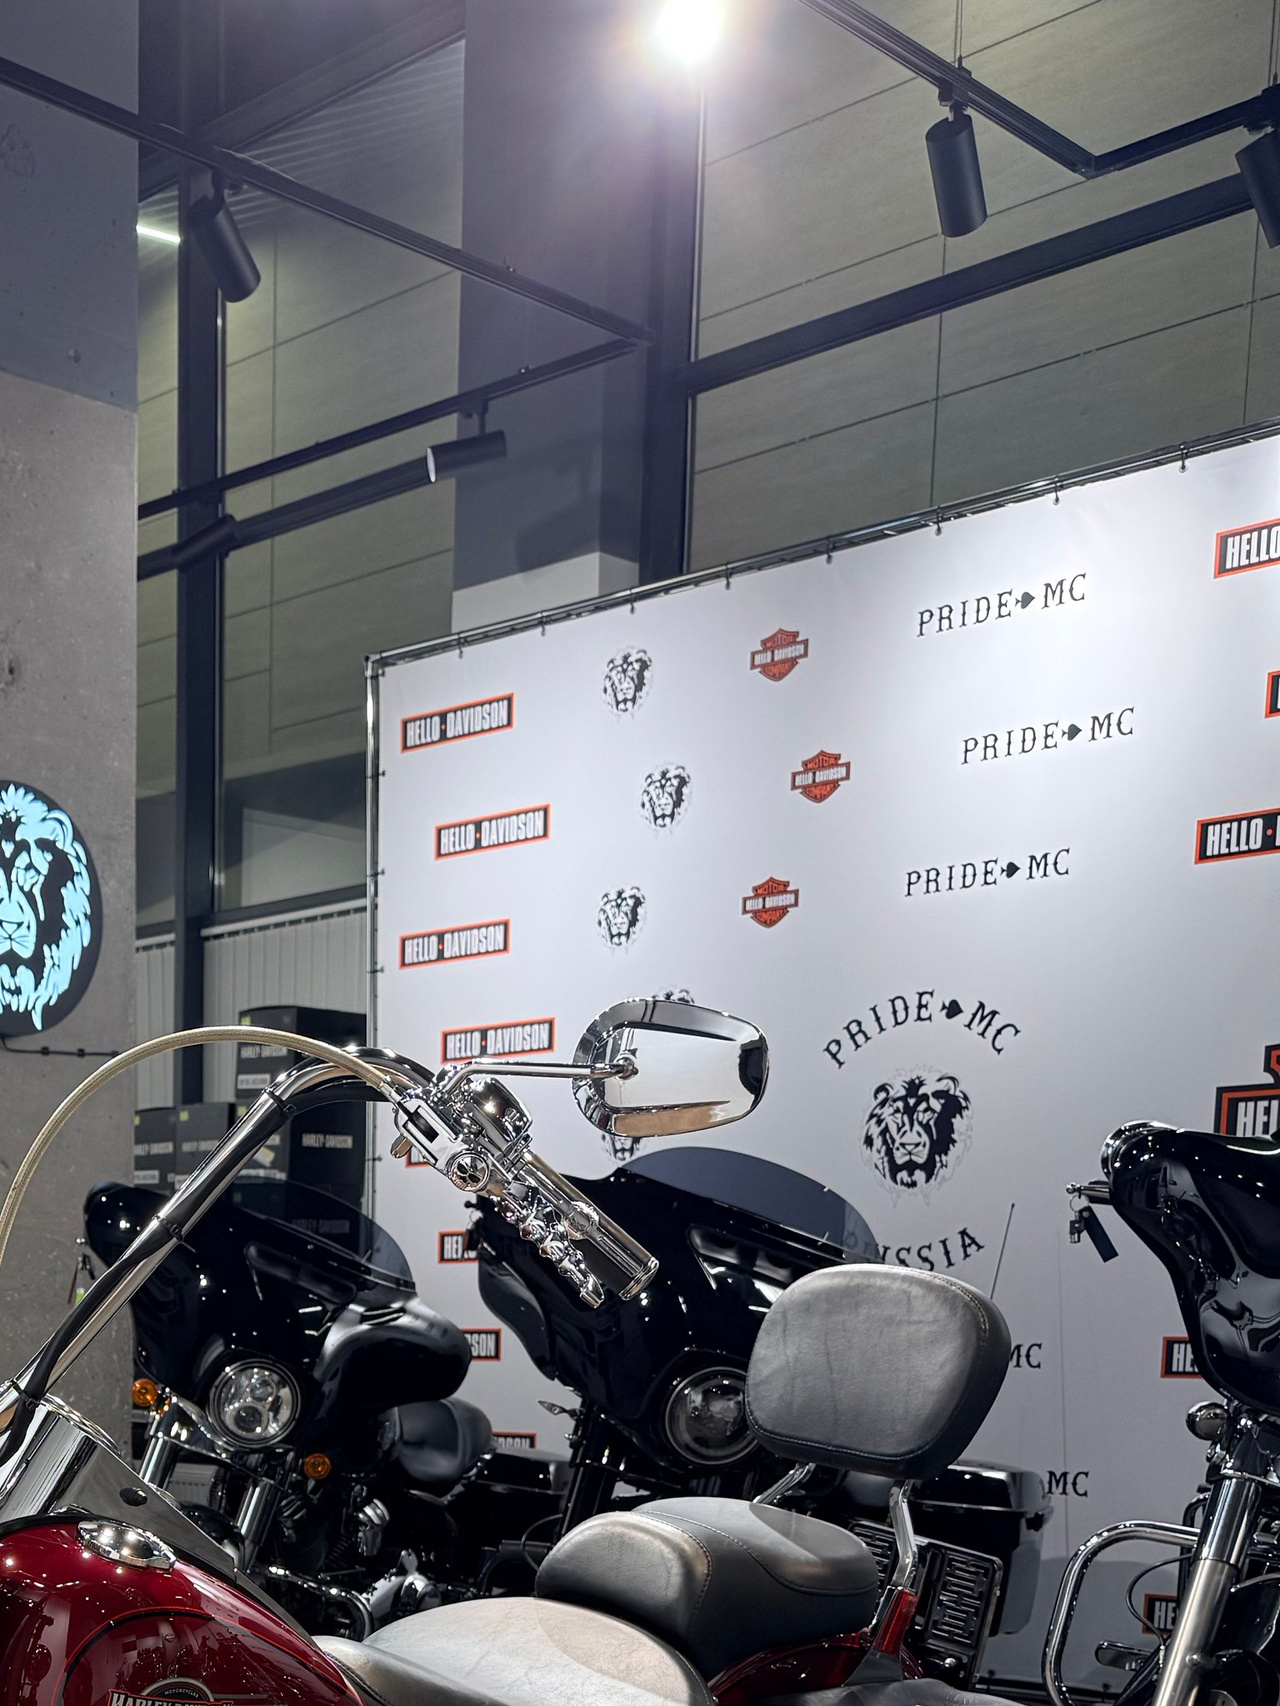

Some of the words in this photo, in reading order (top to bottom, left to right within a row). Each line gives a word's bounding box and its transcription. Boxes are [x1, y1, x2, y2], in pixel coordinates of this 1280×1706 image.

[1225, 525, 1280, 570] HELLO
[916, 588, 1013, 638] PRIDE
[1041, 572, 1087, 610] MC
[406, 715, 441, 748] HELLO
[446, 699, 509, 739] DAVIDSON
[961, 719, 1059, 765] PRIDE
[1088, 706, 1135, 742] MC
[440, 823, 476, 855] HELLO
[480, 809, 545, 848] DAVIDSON
[1206, 817, 1263, 857] HELLO
[904, 857, 999, 897] PRIDE
[1025, 847, 1070, 880] MC
[404, 935, 438, 965] HELLO
[443, 923, 506, 959] DAVIDSON
[446, 1030, 481, 1060] HELLO
[486, 1022, 550, 1055] DAVIDSON
[822, 988, 935, 1069] PRIDE
[963, 1000, 1021, 1055] MC
[1046, 1470, 1090, 1498] MC
